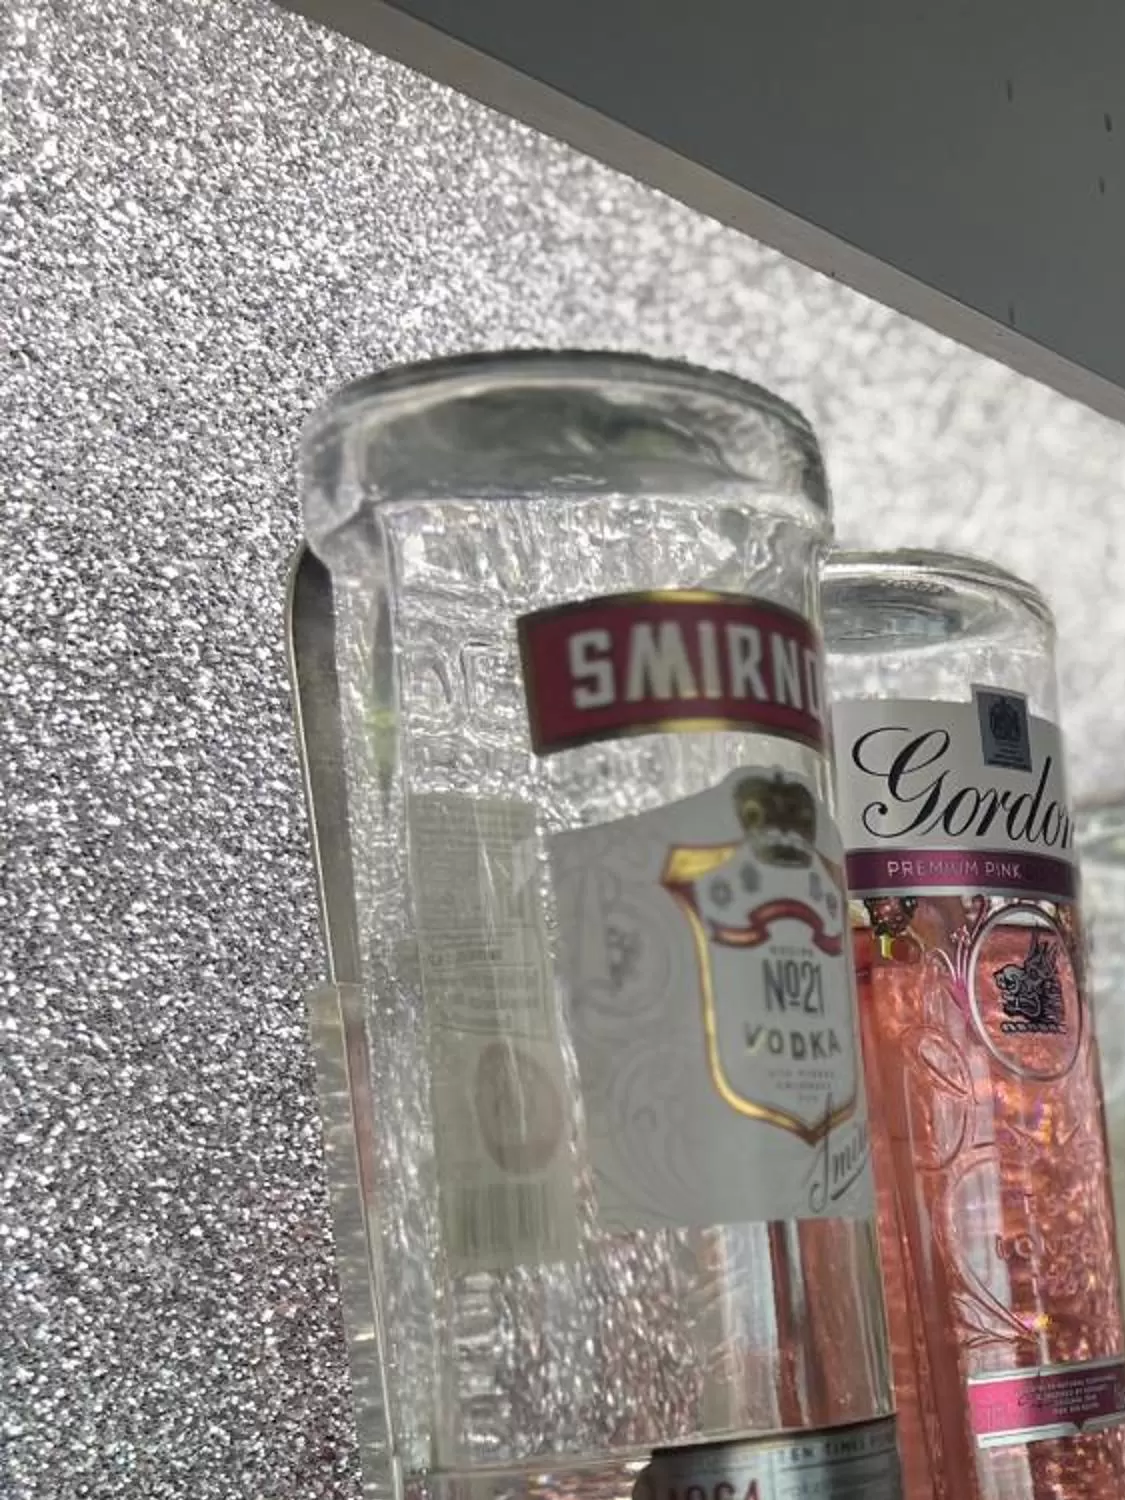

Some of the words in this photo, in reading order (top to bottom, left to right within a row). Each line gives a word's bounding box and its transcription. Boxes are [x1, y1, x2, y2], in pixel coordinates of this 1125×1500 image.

[887, 859, 979, 879] PREMIUM
[985, 861, 1022, 880] PINK
[744, 1023, 842, 1061] VODKA
